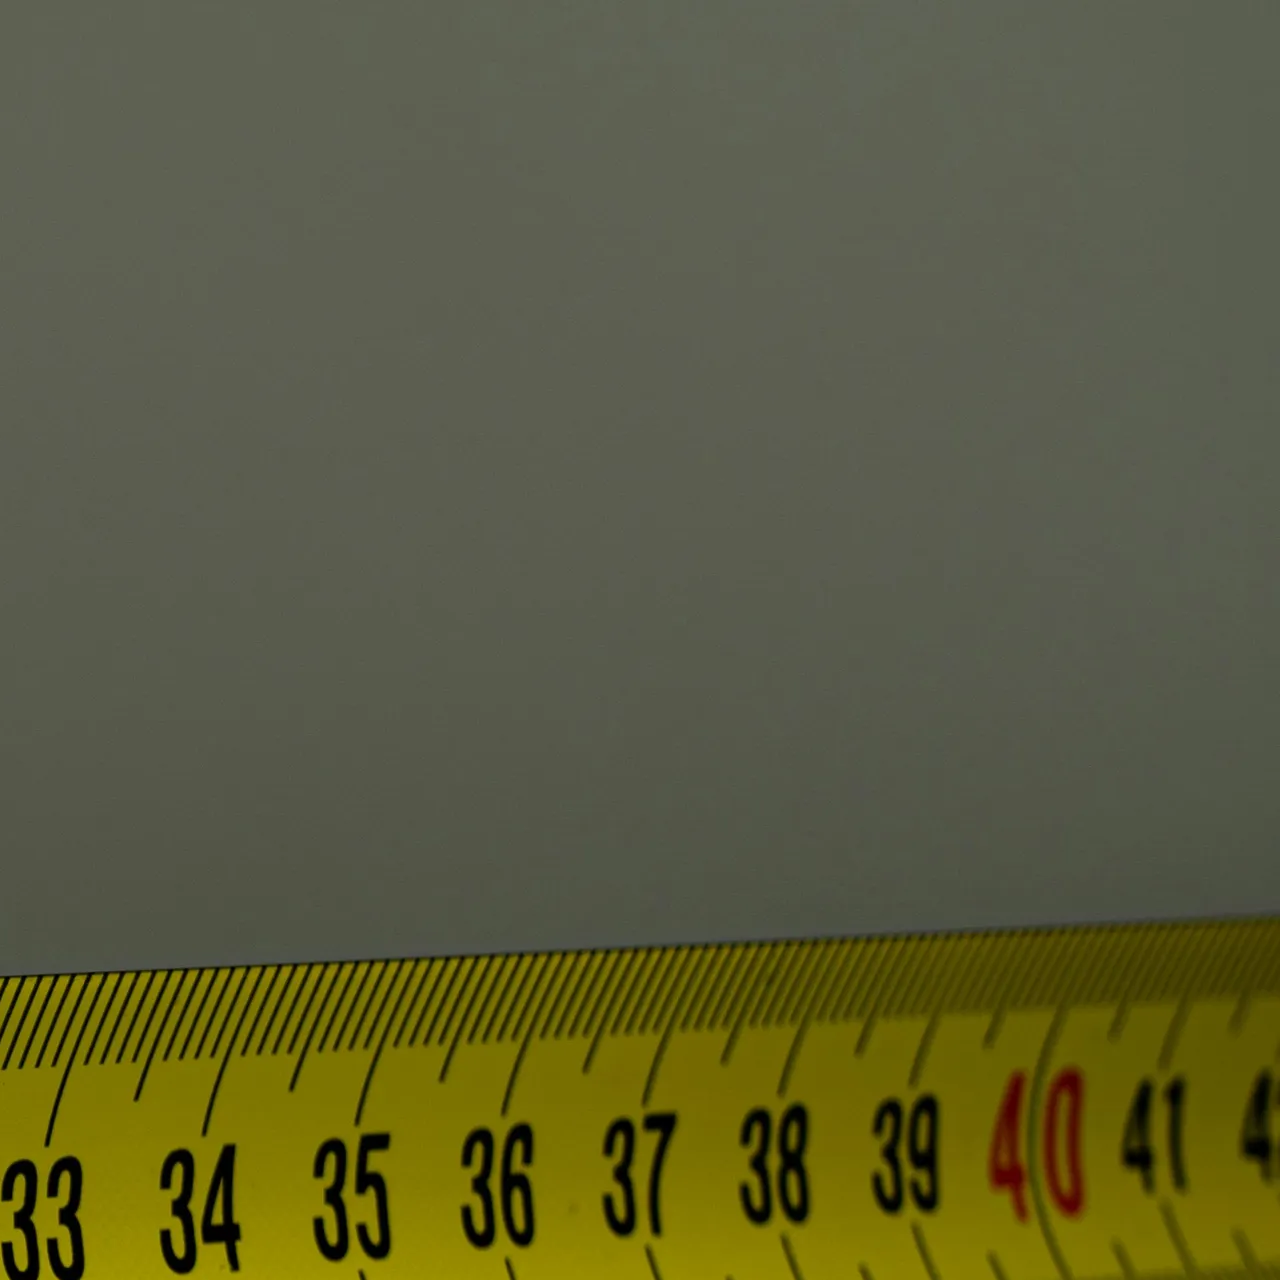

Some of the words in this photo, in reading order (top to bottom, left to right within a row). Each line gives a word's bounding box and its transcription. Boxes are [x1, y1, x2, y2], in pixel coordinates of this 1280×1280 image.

[159, 1144, 241, 1274] 34
[313, 1132, 391, 1261] 35
[461, 1122, 535, 1248] 36
[602, 1112, 677, 1237] 37
[740, 1102, 811, 1226] 38
[871, 1092, 941, 1216] 39
[987, 1064, 1086, 1223] 40
[1121, 1074, 1189, 1195] 41
[1241, 1066, 1280, 1186] 4
